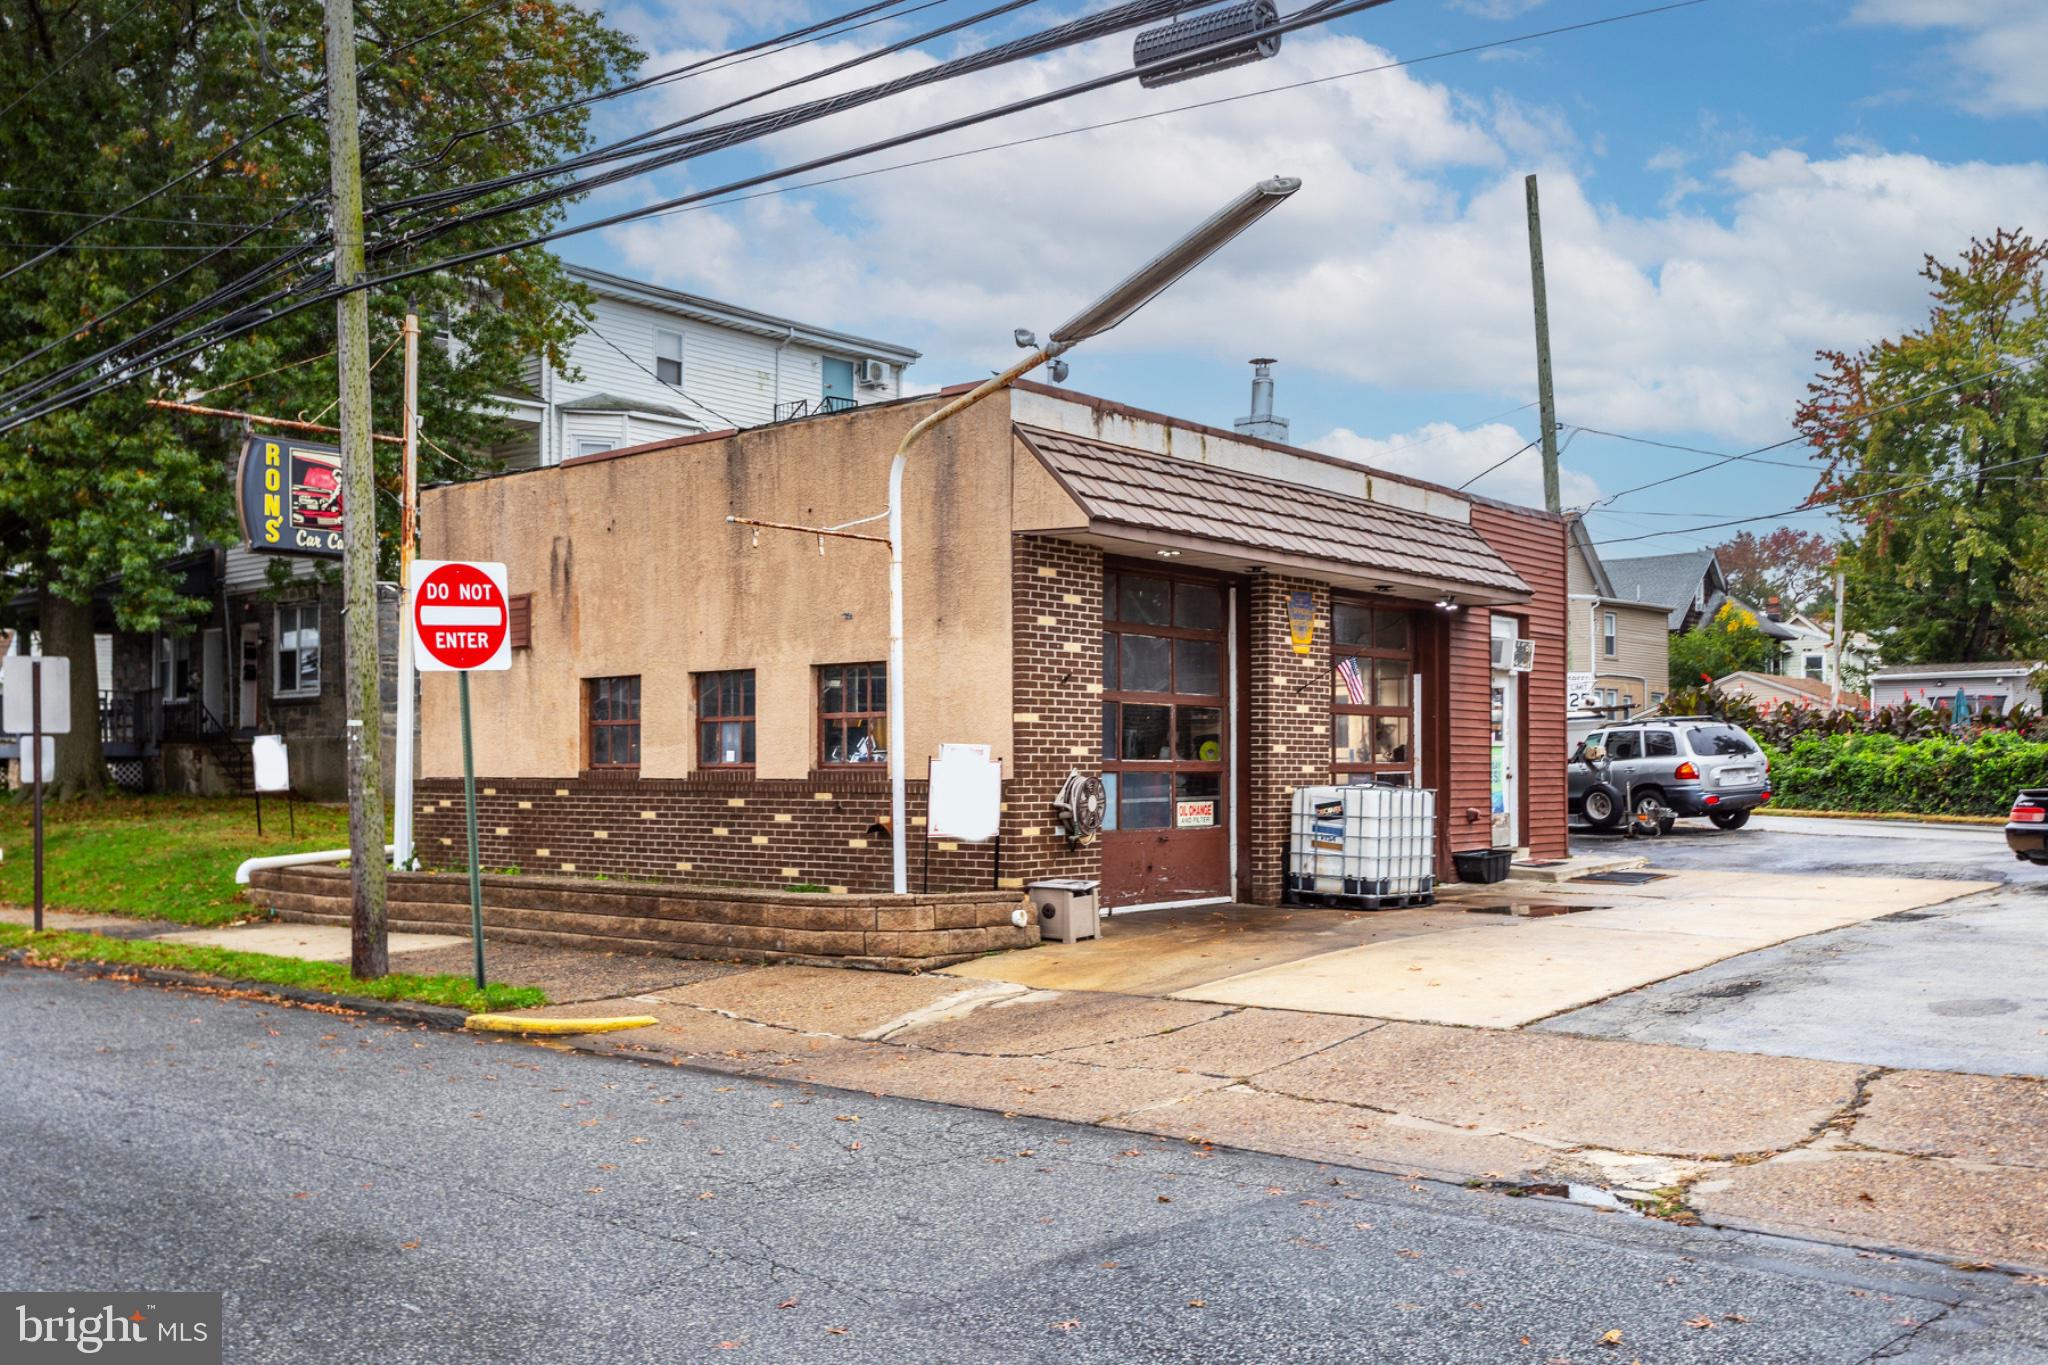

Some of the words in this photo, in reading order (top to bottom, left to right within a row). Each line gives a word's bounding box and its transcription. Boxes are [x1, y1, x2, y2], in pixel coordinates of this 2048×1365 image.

[264, 442, 284, 543] RON'S
[296, 530, 321, 548] Car
[426, 582, 449, 600] DO
[459, 583, 492, 600] NOT
[435, 631, 489, 649] ENTER
[1189, 803, 1212, 816] CHANGE
